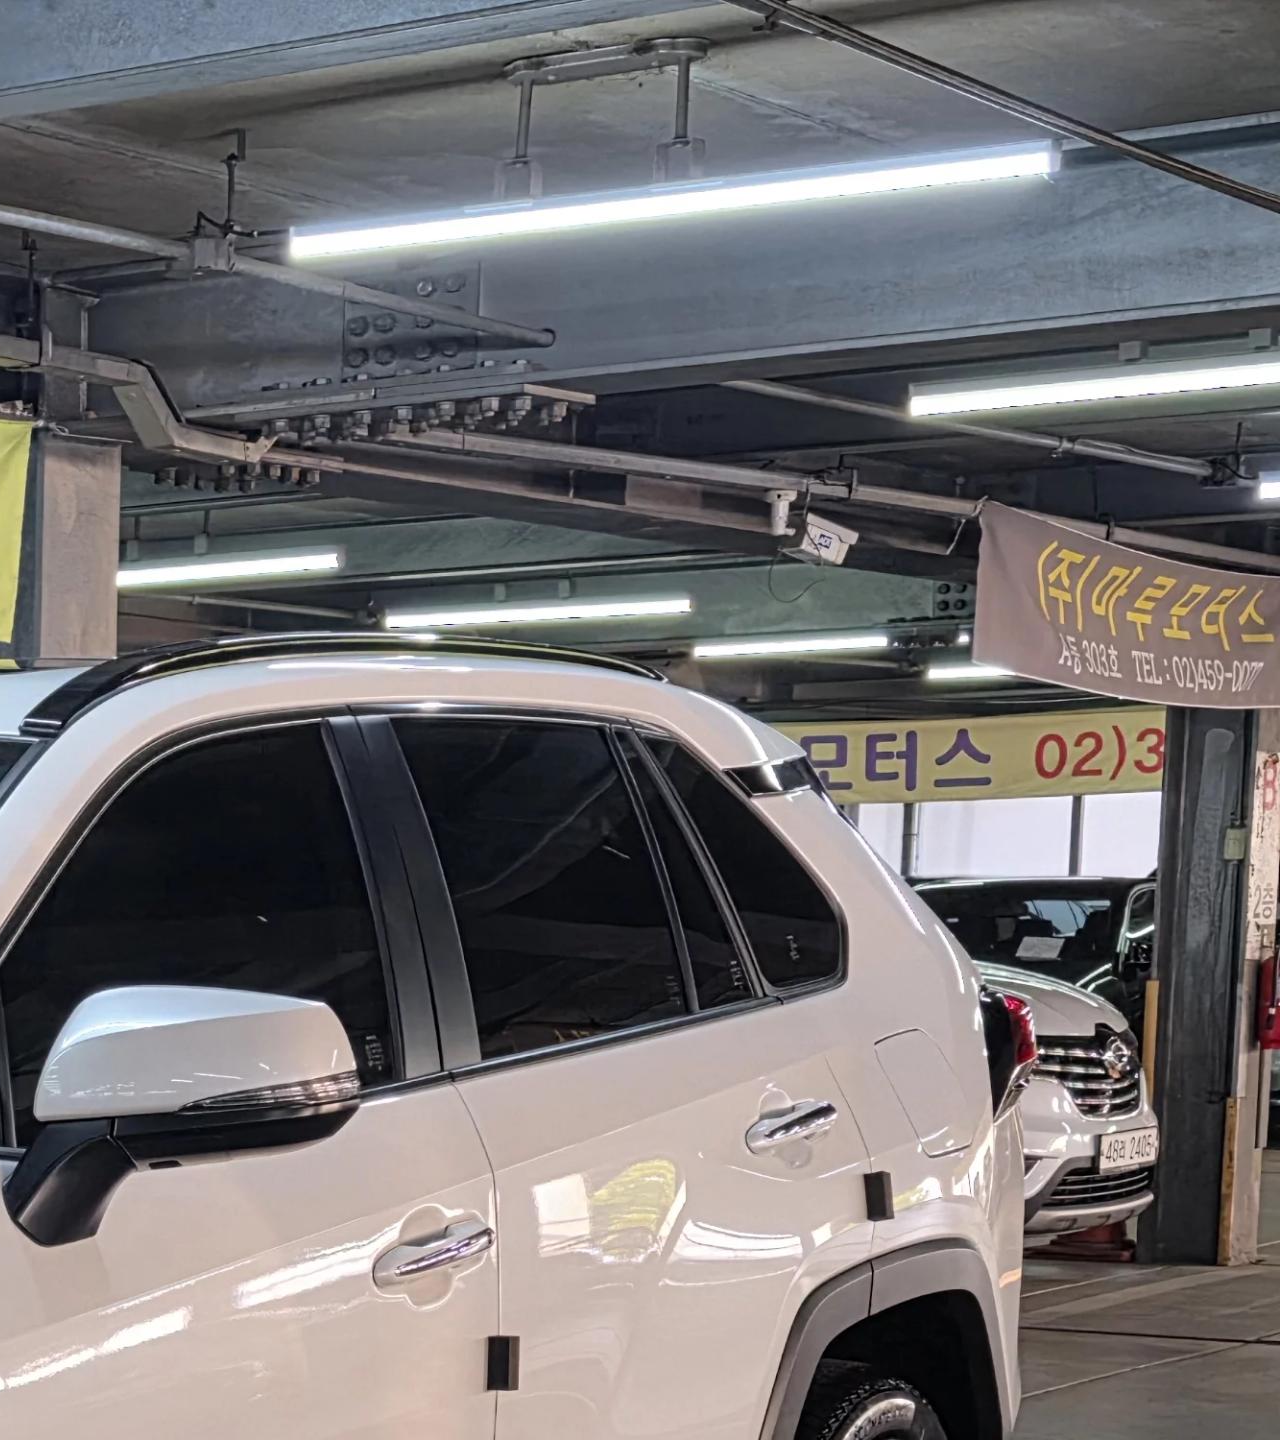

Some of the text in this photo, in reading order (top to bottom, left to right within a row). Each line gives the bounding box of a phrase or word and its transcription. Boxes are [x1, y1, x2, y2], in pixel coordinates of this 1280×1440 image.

[1058, 633, 1082, 675] A동
[1082, 639, 1122, 678] 303호
[800, 725, 1166, 792] 모터스 02)3
